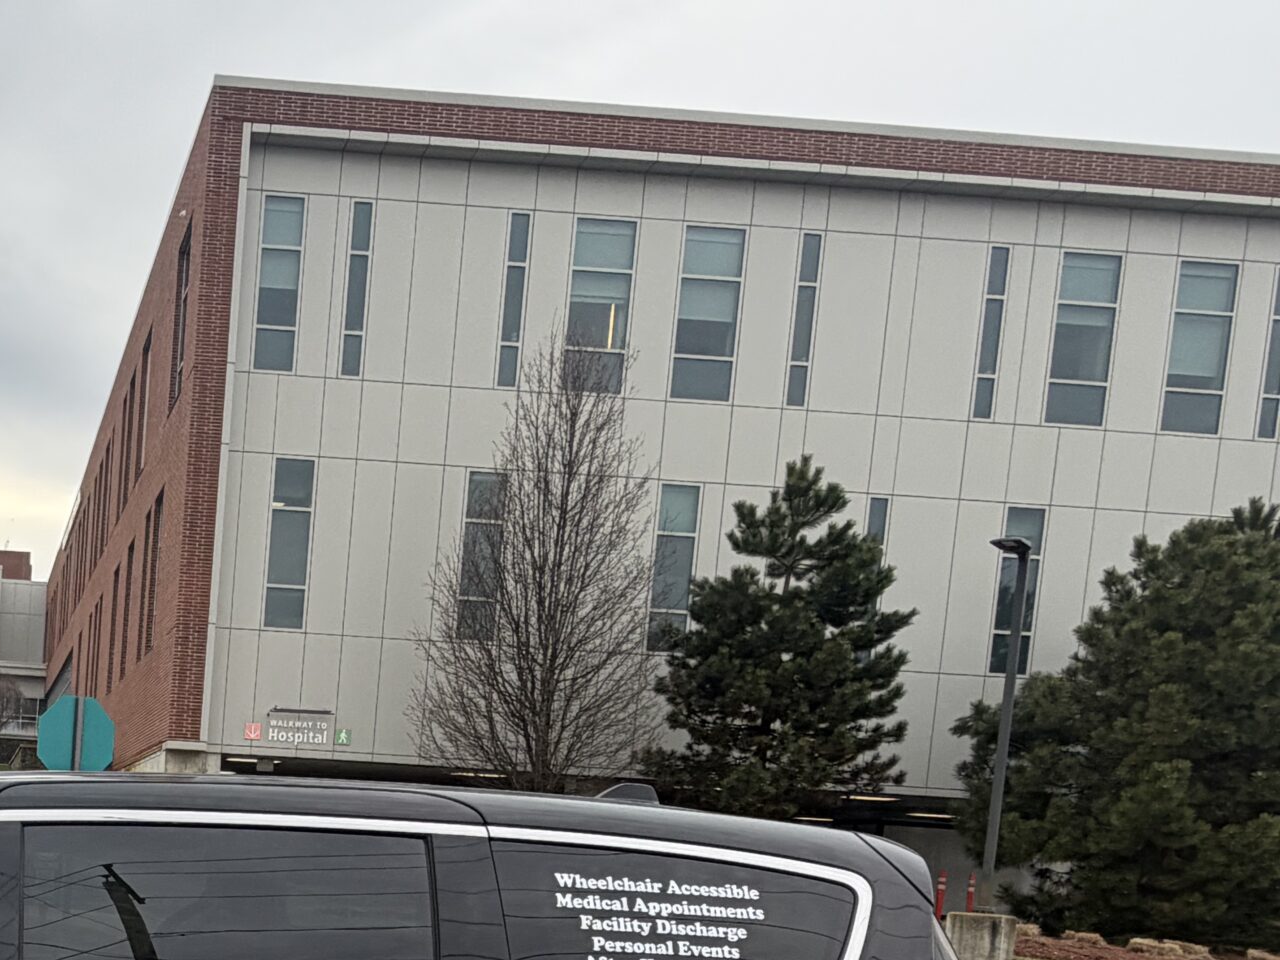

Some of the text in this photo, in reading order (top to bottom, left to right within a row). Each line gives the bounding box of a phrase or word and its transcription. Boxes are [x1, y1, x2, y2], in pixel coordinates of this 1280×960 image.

[268, 727, 328, 746] Hospital
[269, 719, 328, 729] WALKWAY TO
[554, 872, 760, 900] Wheelchair Accessible
[555, 893, 765, 920] Medical Appointments
[580, 914, 748, 942] Facility Discharge
[592, 936, 740, 959] Personal Events
